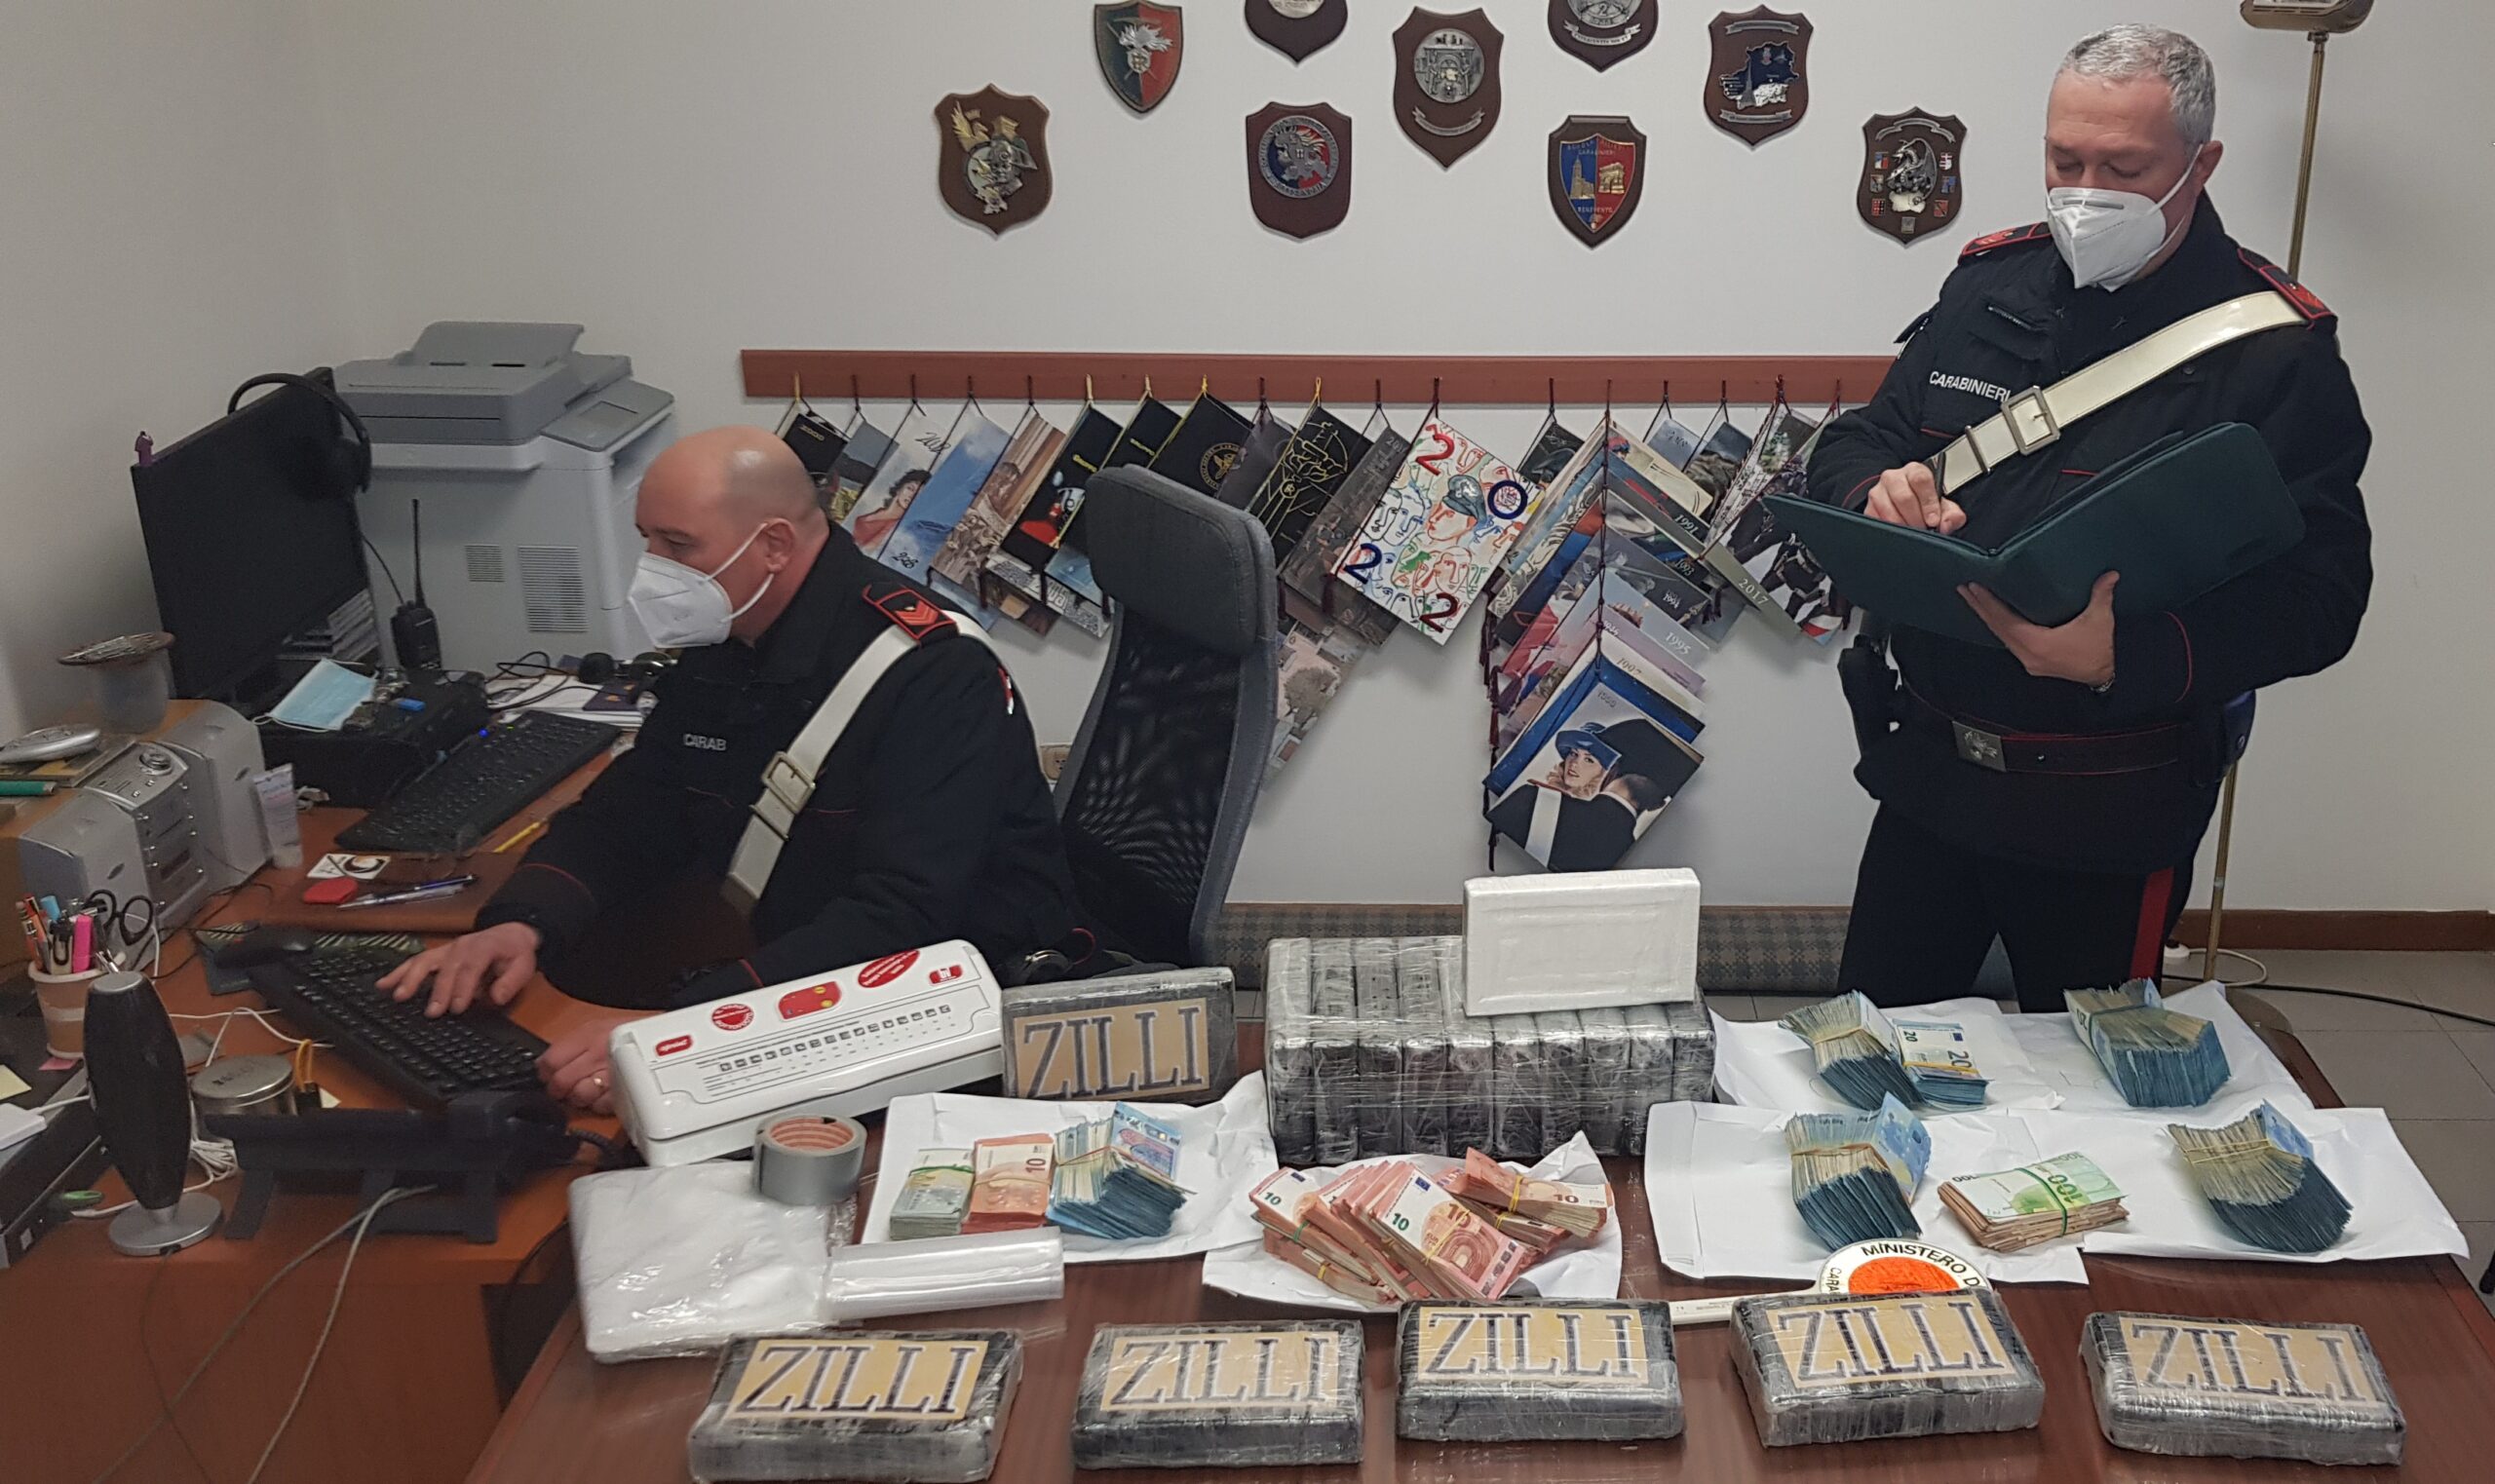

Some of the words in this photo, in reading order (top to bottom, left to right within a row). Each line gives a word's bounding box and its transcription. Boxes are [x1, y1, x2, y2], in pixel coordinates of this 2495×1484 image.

[1929, 371, 2011, 402] CARABINIERI
[1673, 514, 1700, 540] 1991
[1674, 558, 1696, 577] 1993
[1738, 579, 1770, 606] 2017
[1665, 631, 1691, 655] 1995
[1902, 1030, 1918, 1043] 20
[1022, 1006, 1205, 1099] ZILLI
[1946, 1050, 1973, 1068] 20
[1024, 1158, 1047, 1173] 10
[1264, 1192, 1282, 1206] 10
[1554, 1194, 1579, 1203] 10
[2048, 1173, 2084, 1204] 100
[1392, 1212, 1410, 1232] 10
[1861, 1242, 1967, 1275] MINISTERO
[1825, 1267, 1843, 1294] CARA
[1424, 1312, 1640, 1378] ZILLI
[1776, 1301, 2006, 1381] ZILLI
[1109, 1336, 1332, 1406] ZILLI
[2131, 1323, 2367, 1402] ZILLI
[734, 1344, 979, 1414] ZILLI
